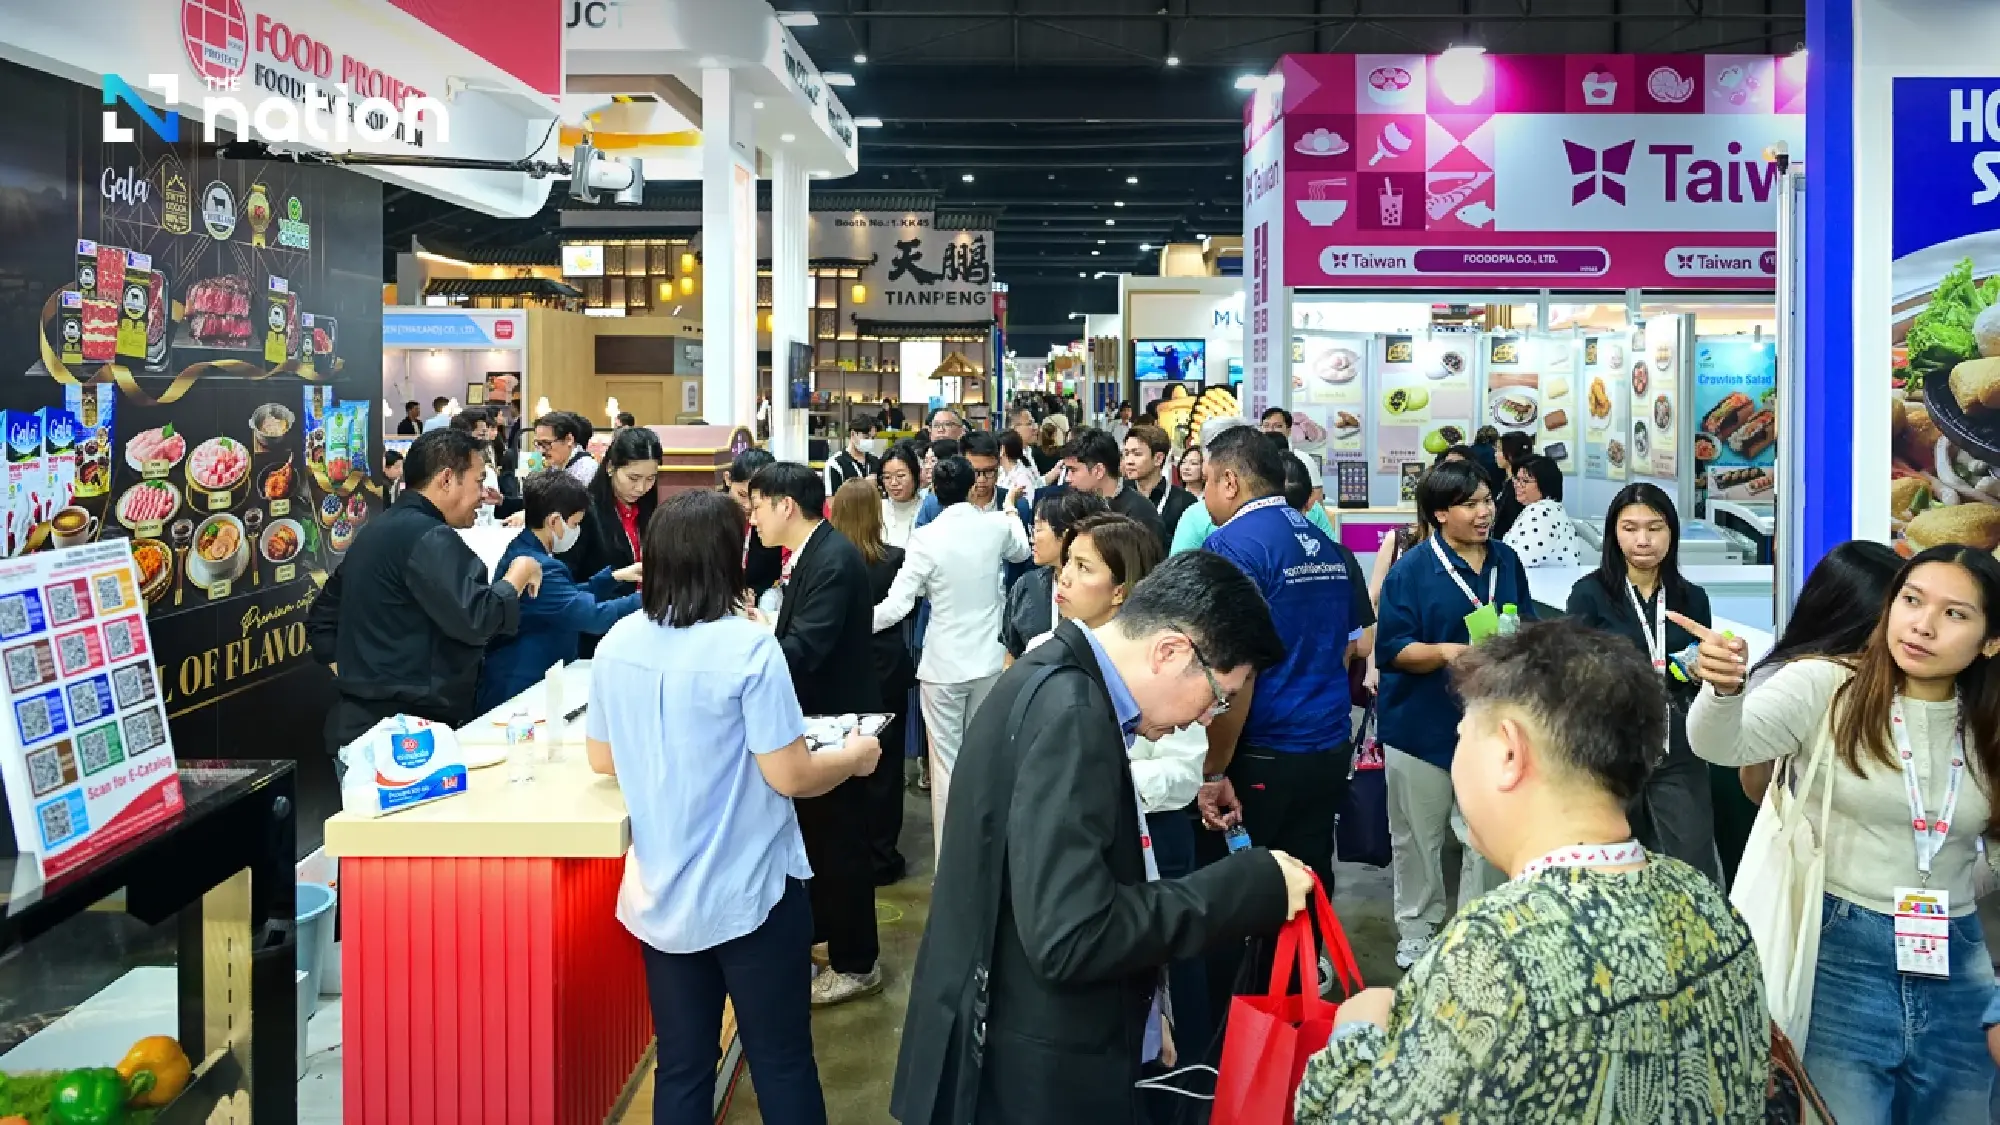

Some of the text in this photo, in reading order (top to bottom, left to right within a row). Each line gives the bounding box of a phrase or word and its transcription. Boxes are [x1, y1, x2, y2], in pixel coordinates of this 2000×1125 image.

[204, 46, 239, 69] PROJECT
[256, 13, 333, 79] FOOD
[1648, 141, 1777, 204] Taiw
[101, 165, 151, 206] Gala
[835, 219, 866, 227] Booth
[1352, 253, 1406, 269] Taiwan
[1463, 254, 1514, 264] FOODOPIA
[1538, 254, 1558, 264] LTD.
[1697, 254, 1752, 270] Taiwan
[885, 291, 986, 305] TIANPENG
[1745, 373, 1772, 386] Salad
[241, 605, 296, 638] Premium
[180, 647, 220, 696] OF
[225, 621, 313, 681] FLAVO
[87, 755, 173, 801] Scan for E-Catalog
